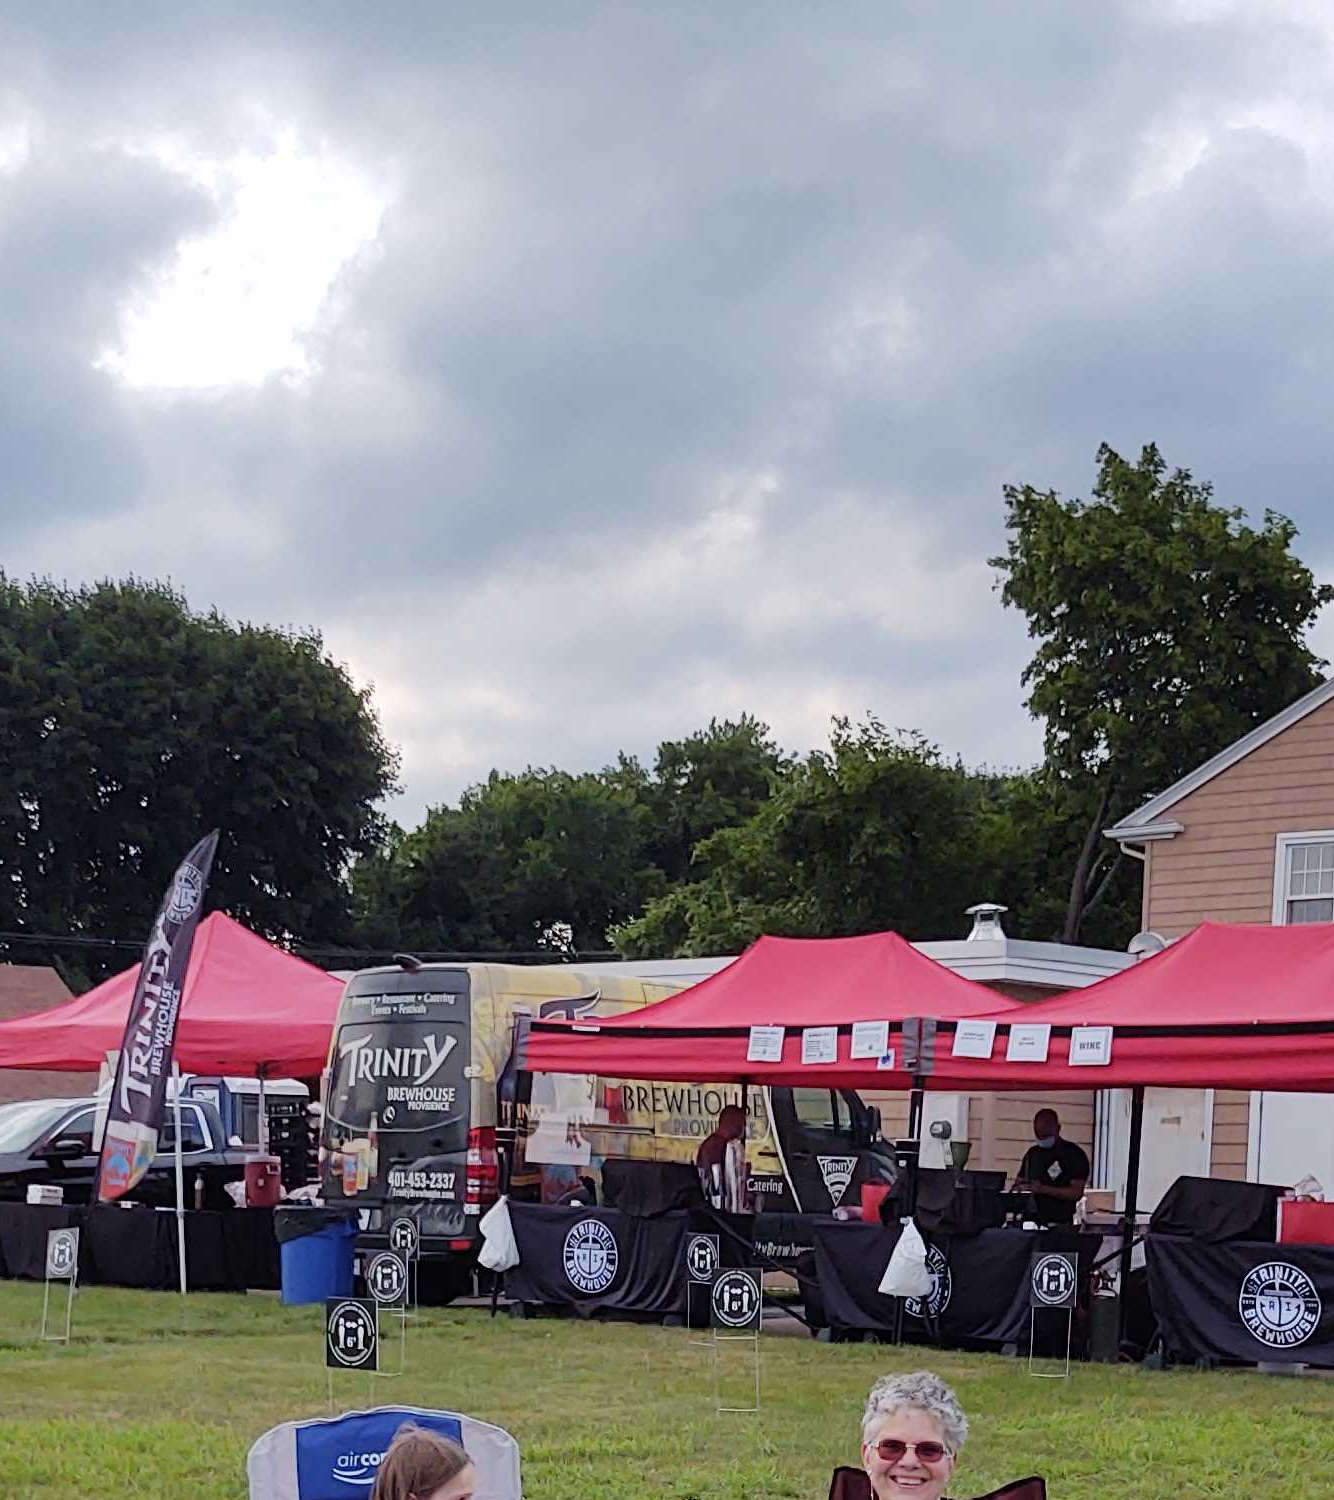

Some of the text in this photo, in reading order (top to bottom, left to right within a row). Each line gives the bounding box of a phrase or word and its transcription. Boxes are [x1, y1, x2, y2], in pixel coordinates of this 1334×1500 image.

[120, 912, 172, 1114] TRINITY
[150, 981, 175, 1076] BREWHOUSE
[1079, 1040, 1102, 1051] WINE
[340, 1033, 458, 1087] TRINITY
[387, 1087, 456, 1102] BREWHOUSE
[819, 1159, 856, 1175] TRINITY
[388, 1171, 456, 1190] 401-453-2337
[747, 1178, 784, 1194] Catering
[572, 1222, 610, 1241] TRINITY
[566, 1260, 616, 1291] BREWHOUSE
[1249, 1265, 1307, 1288] TRINITY
[1243, 1308, 1317, 1345] BREWHOUSE
